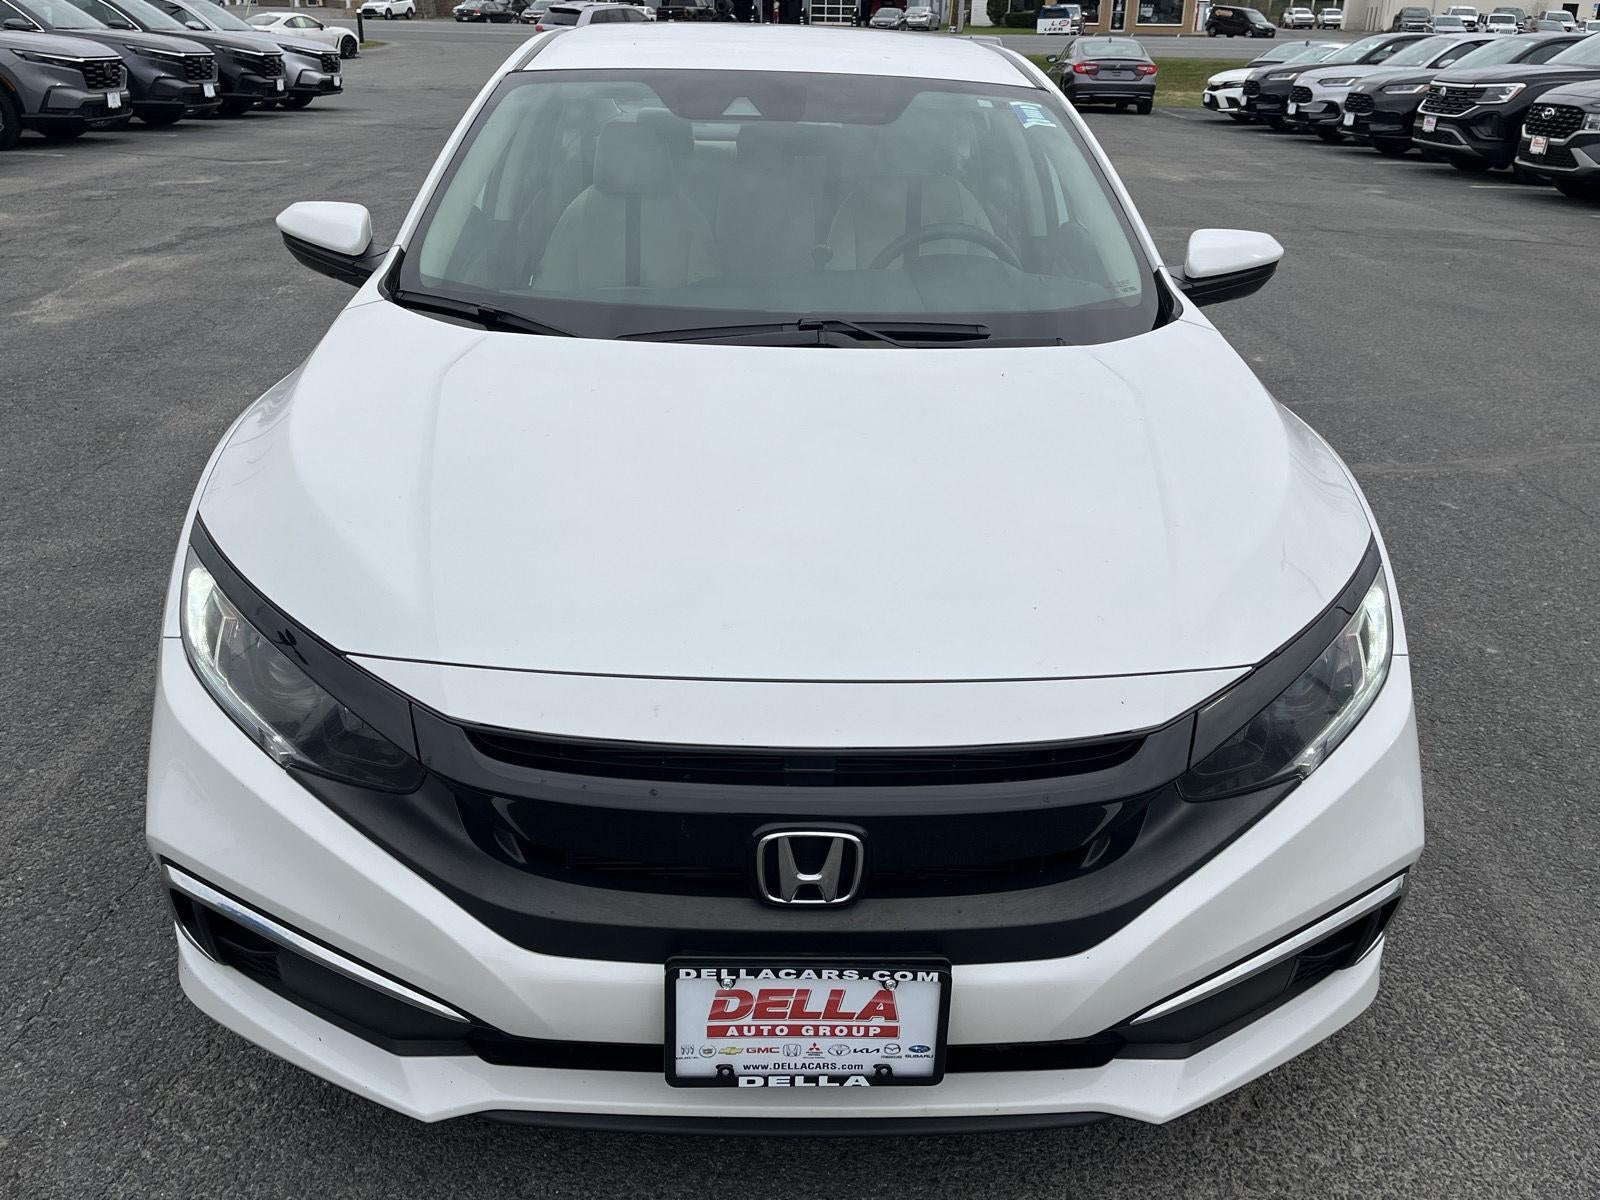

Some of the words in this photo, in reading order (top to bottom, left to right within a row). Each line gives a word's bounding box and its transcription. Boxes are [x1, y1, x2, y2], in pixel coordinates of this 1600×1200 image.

[679, 968, 939, 983] DELLACARS.COM
[707, 988, 900, 1022] DELLA
[726, 1025, 789, 1037] AUTO
[801, 1025, 881, 1037] GROUP
[742, 1062, 864, 1071] www.DELLACARS.com
[738, 1075, 871, 1088] DELLA
